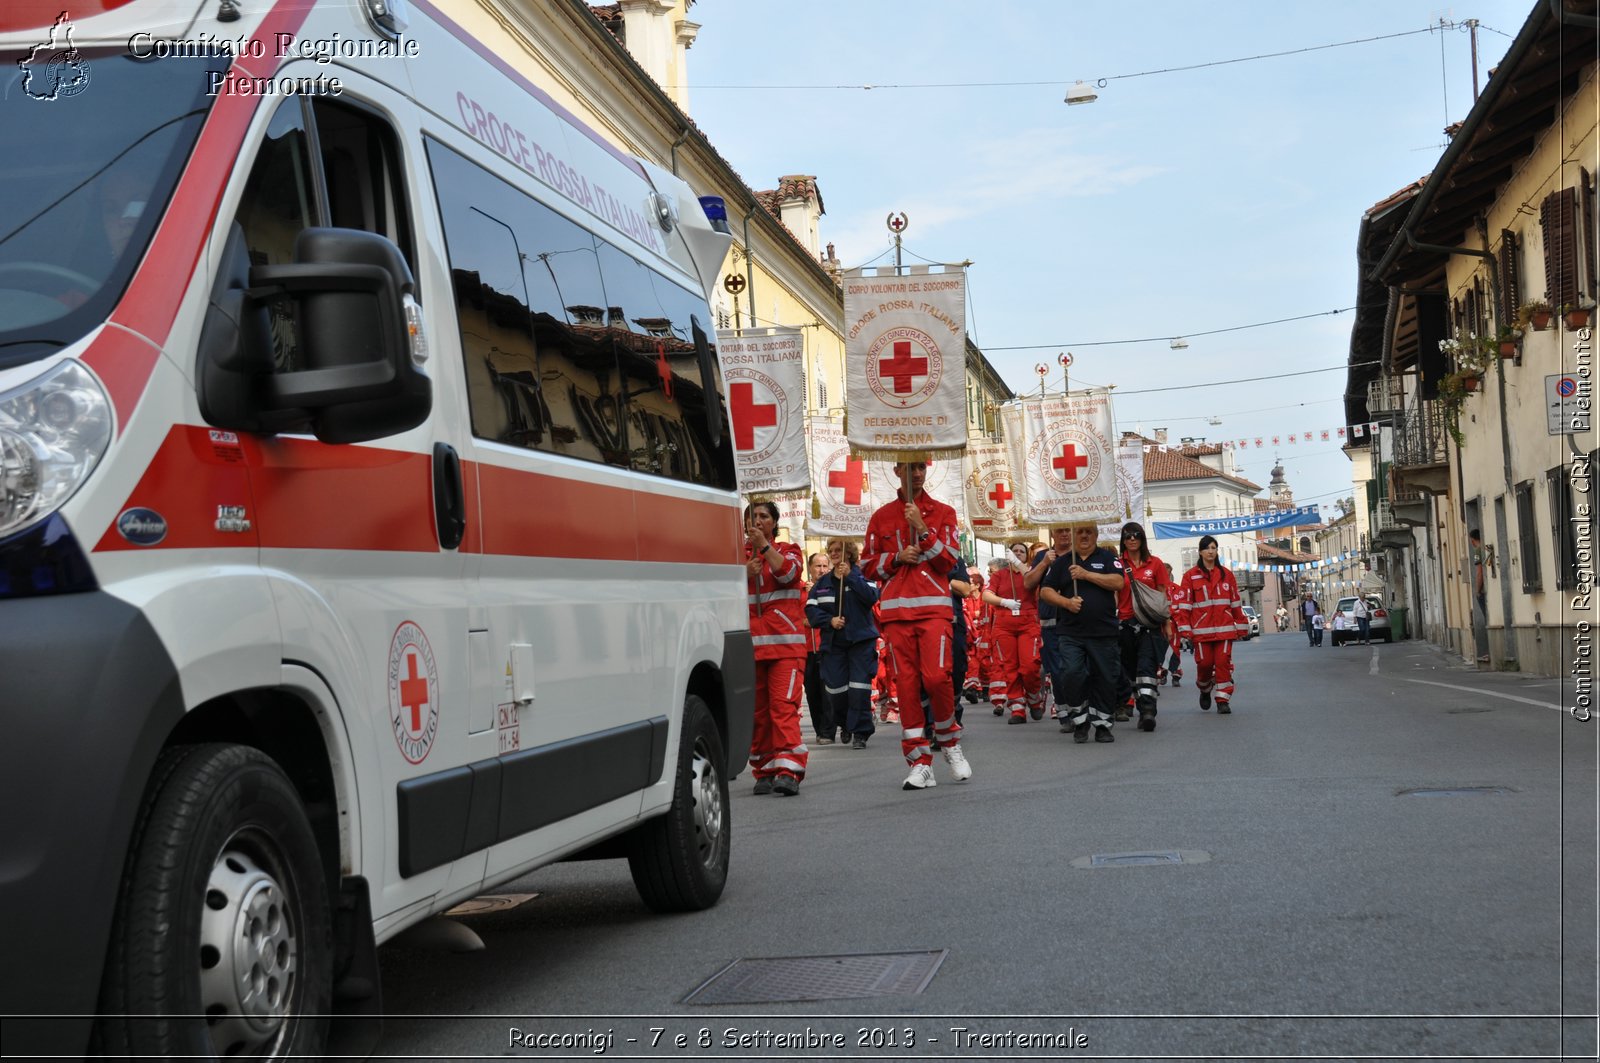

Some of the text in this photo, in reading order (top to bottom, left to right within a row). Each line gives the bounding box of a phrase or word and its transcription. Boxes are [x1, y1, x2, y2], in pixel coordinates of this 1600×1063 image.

[457, 91, 661, 252] CROCE ROSSA ITALIANA
[848, 281, 960, 295] CORPO VOLONTARI DEL SOCCORSO
[848, 300, 960, 339] CROCE ROSSA ITALIANA
[721, 340, 796, 353] ONTARI DEL SOCCORSO
[757, 351, 802, 363] ITALIANA
[866, 329, 941, 398] CONVENZIONE DI GINEVRA 22 AGOSTO 1864
[748, 370, 756, 378] DI
[758, 373, 786, 404] GINEVRA
[863, 415, 948, 427] DELEGAZIONE DI
[874, 433, 934, 444] PAESANA
[1028, 418, 1112, 459] CROCE ROSSA ITALIANA
[744, 464, 795, 476] LOCALE DI
[981, 459, 1006, 469] ROSSA
[1115, 464, 1141, 493] TALIANA
[1035, 497, 1070, 507] COMITATO
[1073, 496, 1103, 504] LOCALE
[1071, 504, 1115, 513] DALMAZZO
[820, 514, 868, 523] DELEGAZION
[1189, 516, 1281, 532] ARRIVEDERCI
[823, 523, 867, 531] PEVERAG
[500, 707, 509, 726] CN
[393, 709, 437, 759] RACCONIGI
